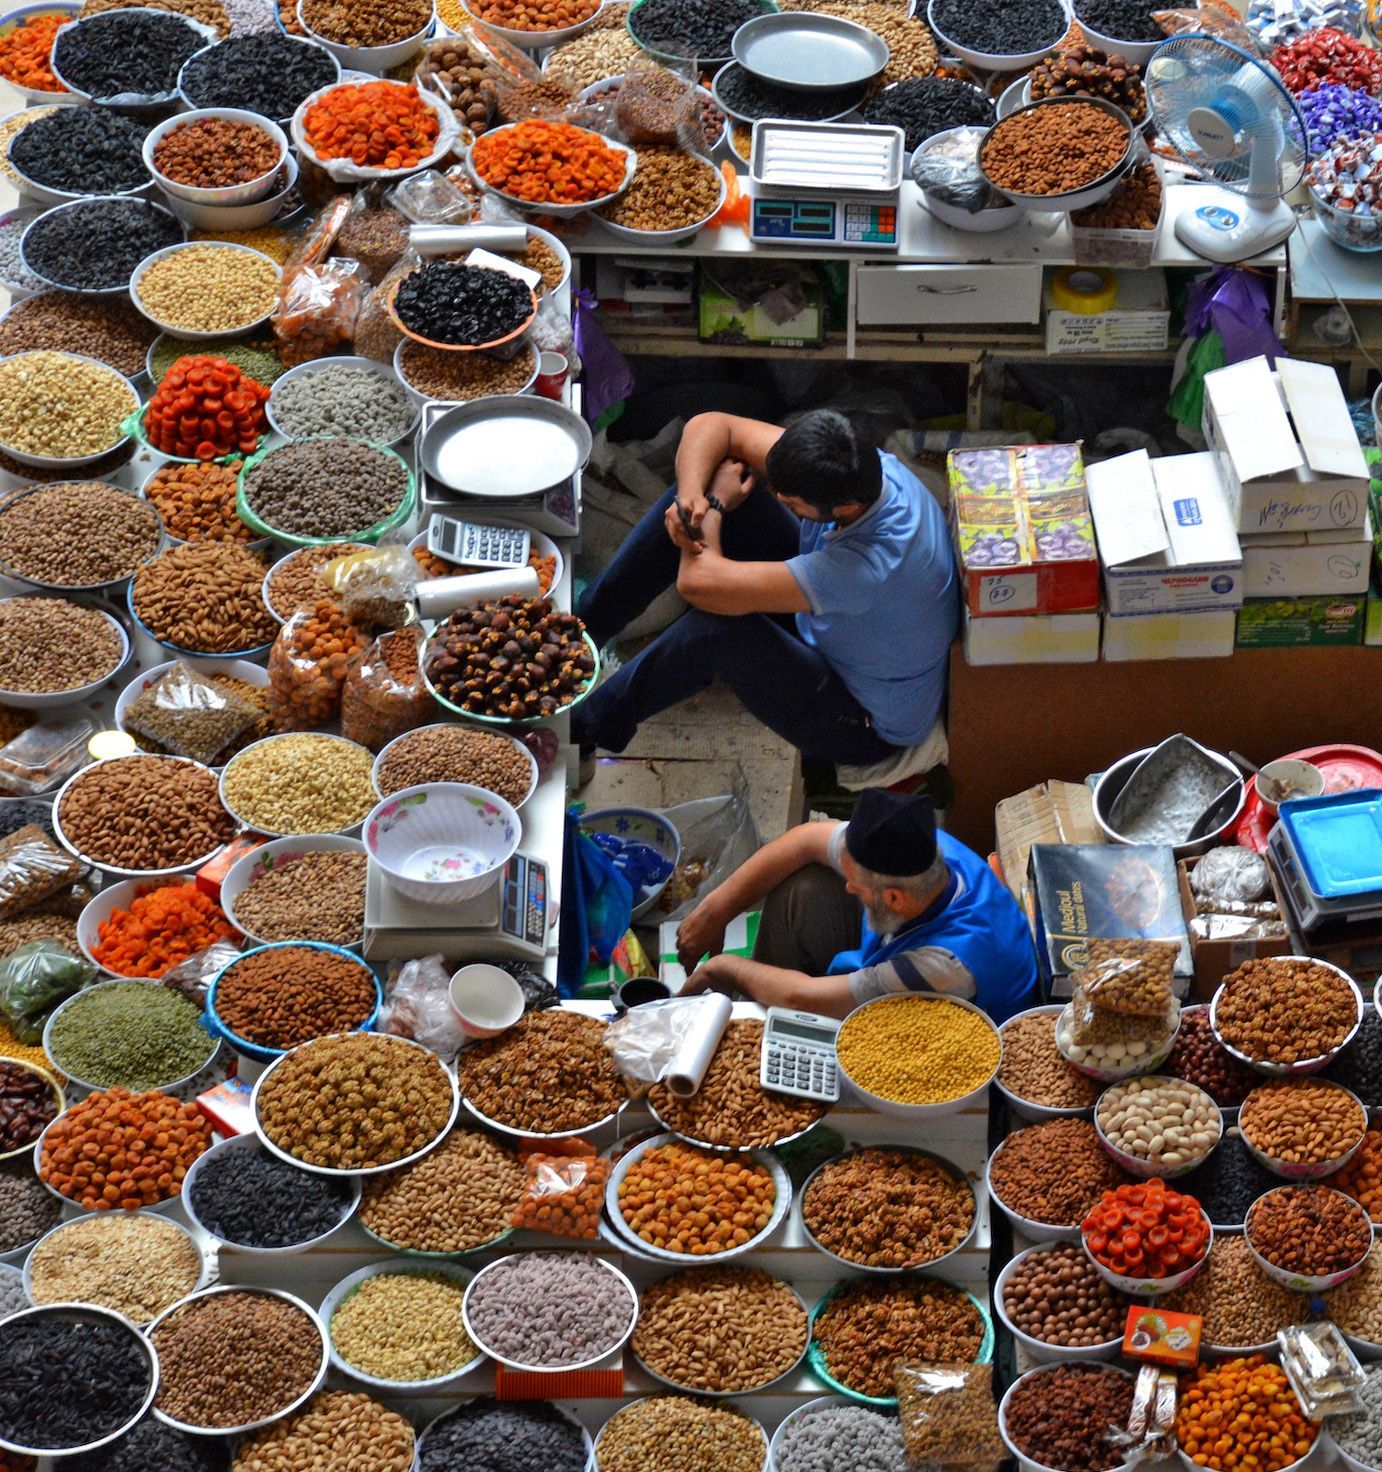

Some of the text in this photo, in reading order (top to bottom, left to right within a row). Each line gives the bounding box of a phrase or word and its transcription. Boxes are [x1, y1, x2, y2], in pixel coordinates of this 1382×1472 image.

[1056, 890, 1076, 933] Medjoul
[1071, 881, 1088, 934] Natural dates
